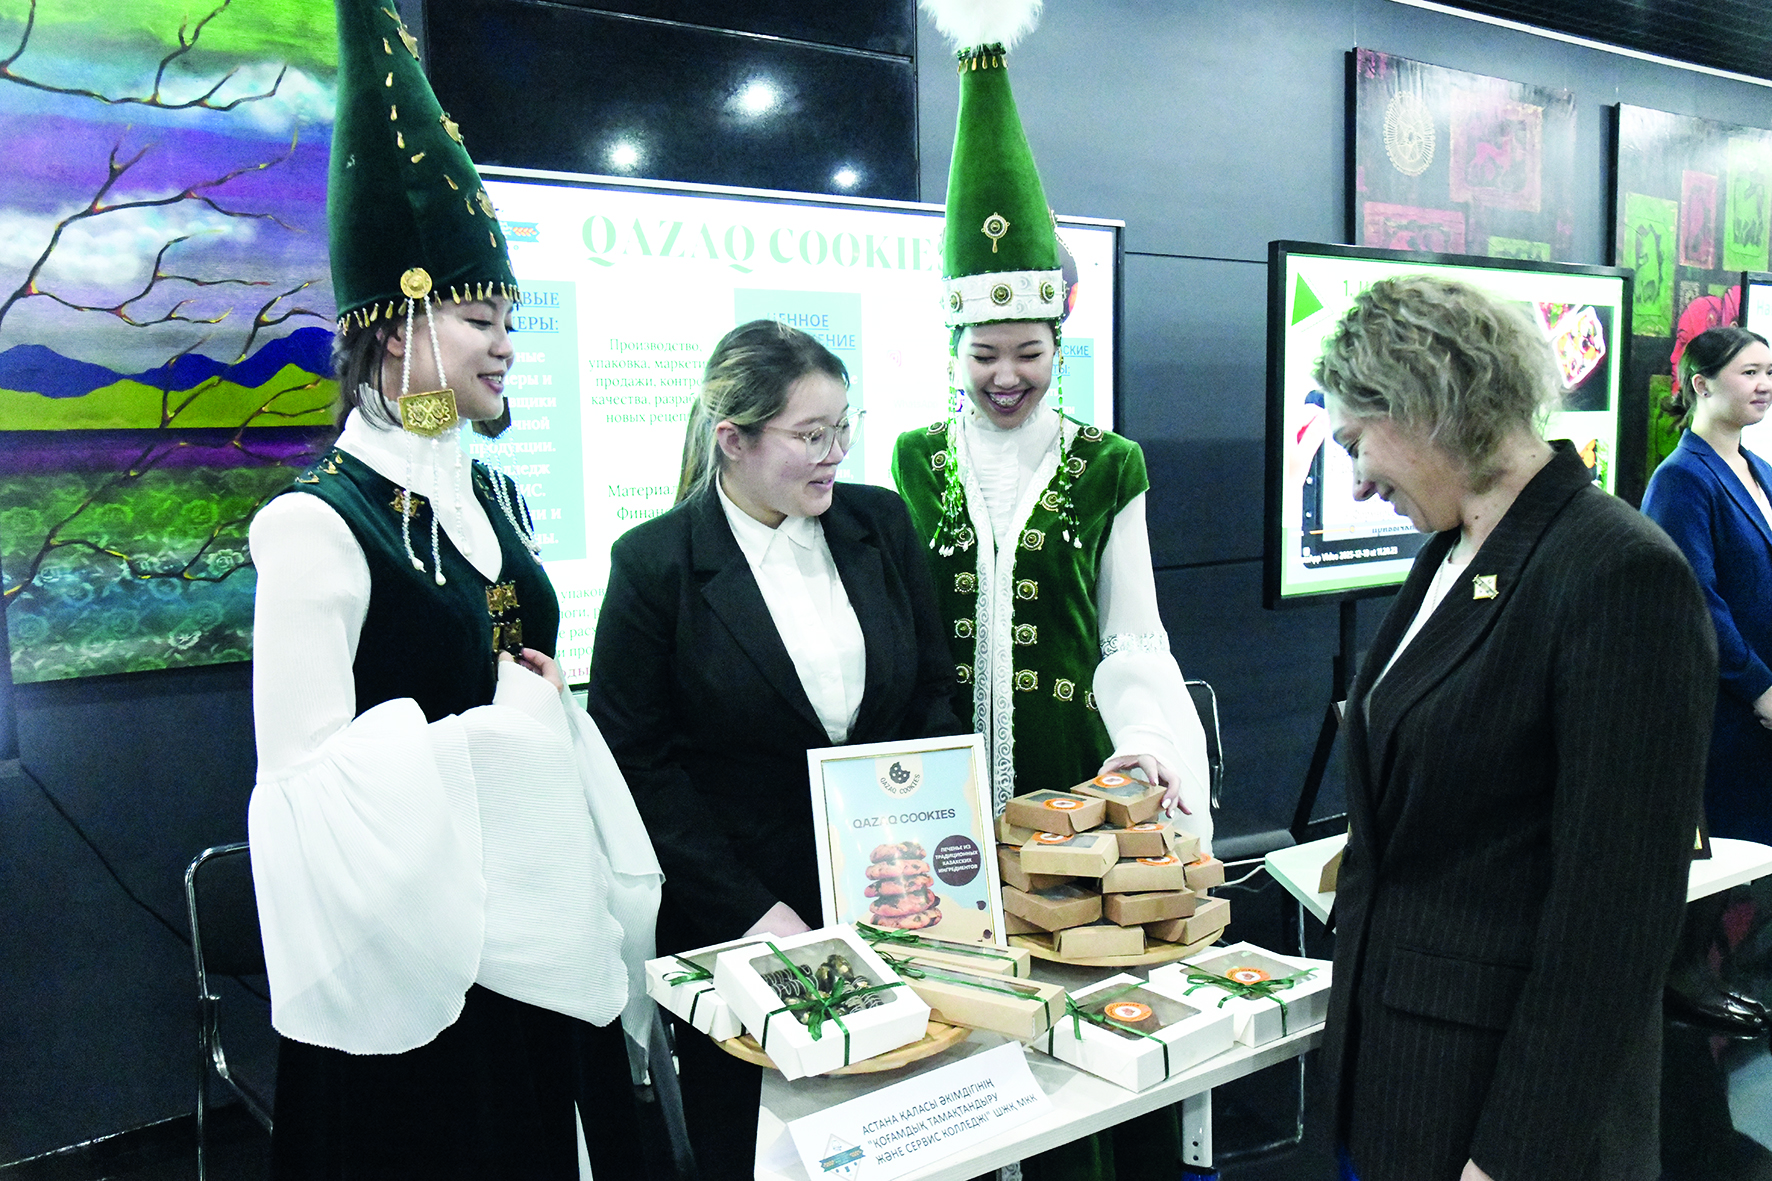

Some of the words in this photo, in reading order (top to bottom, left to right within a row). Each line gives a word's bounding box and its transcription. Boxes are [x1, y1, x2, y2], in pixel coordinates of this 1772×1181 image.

[582, 214, 755, 273] QAZAQ
[522, 291, 560, 306] ВЫЕ
[513, 316, 559, 330] ЕРЫ:
[610, 338, 702, 353] Производство,
[1062, 345, 1089, 356] СКИЕ
[516, 351, 546, 363] ные
[588, 359, 650, 372] упаковка,
[595, 378, 657, 390] продажи,
[660, 378, 703, 389] контро
[509, 397, 557, 410] вщики
[591, 395, 651, 405] качества,
[654, 392, 696, 407] разраб
[512, 416, 550, 431] чной
[606, 414, 646, 423] новых
[649, 413, 690, 425] рецеп
[608, 484, 679, 500] Материал
[560, 588, 605, 604] упаков
[569, 646, 593, 659] про
[853, 815, 898, 829] QAZAQ
[899, 808, 956, 824] COOKIES
[862, 1114, 899, 1135] АСТАНА
[899, 1099, 939, 1122] ҚАЛАСЫ
[938, 1078, 995, 1106] ӘКІМДІГІНІҢ
[867, 1121, 929, 1149] "ҚОҒАМДЫҚ
[926, 1092, 999, 1127] ТАМАҚТАНДЫРУ
[875, 1146, 905, 1165] ЖӘНЕ
[905, 1132, 942, 1153] СЕРВИС
[942, 1111, 991, 1138] КОЛЛЕДЖІ"
[992, 1102, 1018, 1117] ШЖҚ
[1016, 1093, 1038, 1108] МКК
